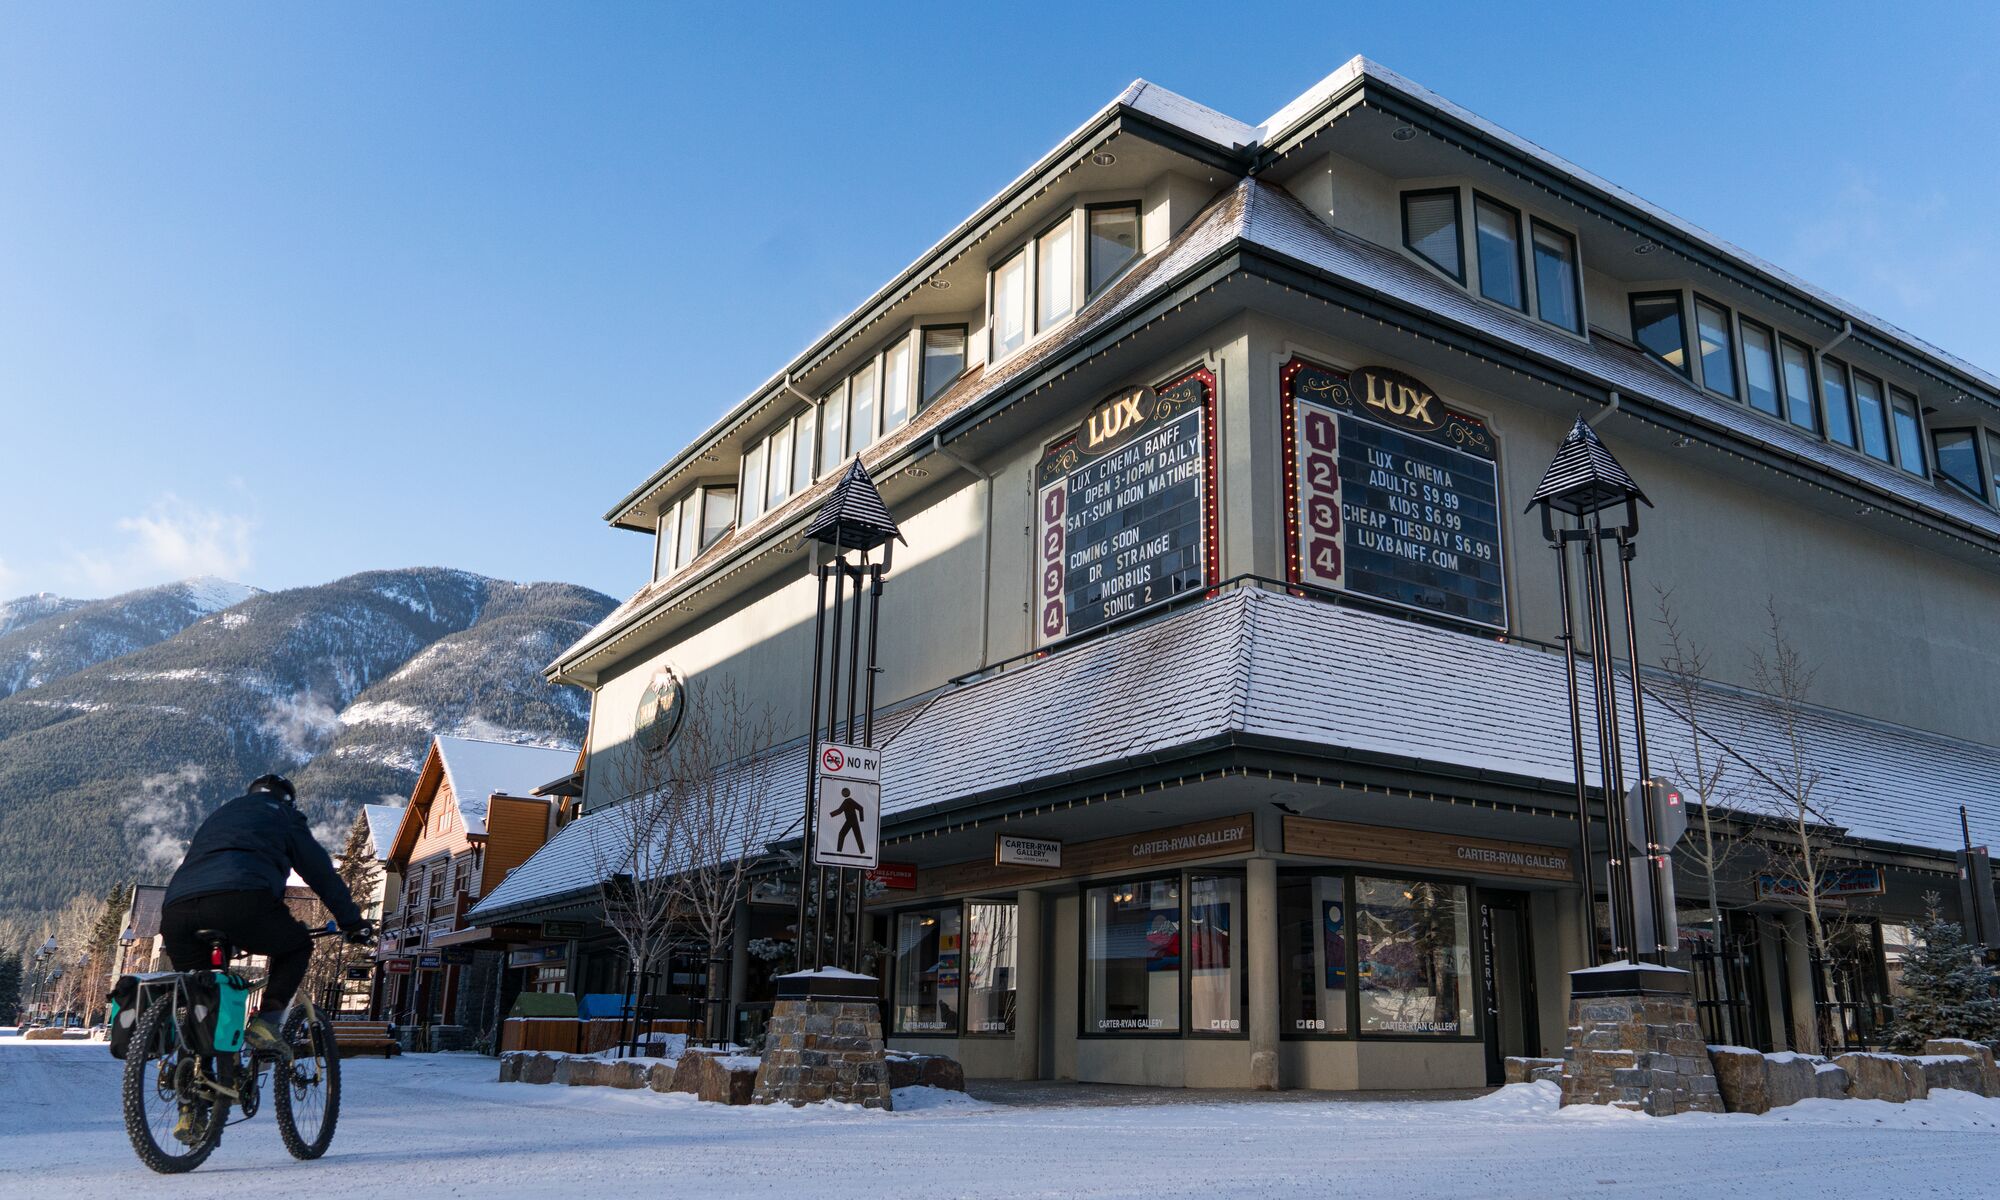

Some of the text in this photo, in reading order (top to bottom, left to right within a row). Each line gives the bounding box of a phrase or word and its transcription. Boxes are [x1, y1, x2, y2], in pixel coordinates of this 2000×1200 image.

[1365, 373, 1435, 425] LUX
[1088, 390, 1145, 448] LUX
[1314, 421, 1326, 445] 1
[1071, 425, 1180, 494] LUX CINEMA BANFF
[1085, 437, 1197, 504] OPEN 3-10PM DAILY
[1367, 448, 1453, 488] LUX CINEMA
[1313, 462, 1332, 487] 2
[1369, 470, 1418, 497] ADULTS
[1050, 495, 1058, 511] 1
[1067, 458, 1201, 532] SAT-SUN NOON MATINEE
[1388, 495, 1419, 519] KIDS
[1314, 504, 1333, 528] 3
[1343, 503, 1387, 529] CHEAP
[1391, 517, 1449, 547] TUESDAY
[1048, 534, 1060, 552] 2
[1070, 526, 1140, 570] COMING SOON
[1358, 529, 1459, 571] LUXBANFF.COM
[1089, 534, 1169, 583] DR STRANGE
[1316, 547, 1335, 572] 4
[1047, 573, 1059, 592] 3
[1102, 564, 1151, 599] MORBIUS
[1103, 585, 1152, 618] SONIC 2
[1047, 608, 1059, 628] 4
[847, 756, 878, 771] NO RV
[1005, 840, 1058, 852] CARTER-RYAN
[1016, 848, 1047, 858] GALLERY
[1132, 827, 1245, 856] CARTER-RYAN GALLERY
[1457, 847, 1567, 870] CARTER-RYAN GALLERY
[1480, 904, 1492, 991] GALLERY
[1098, 1019, 1163, 1029] CARTER-RYAN GALLERY
[1380, 1021, 1458, 1032] CARTER-RYAN GALLERY
